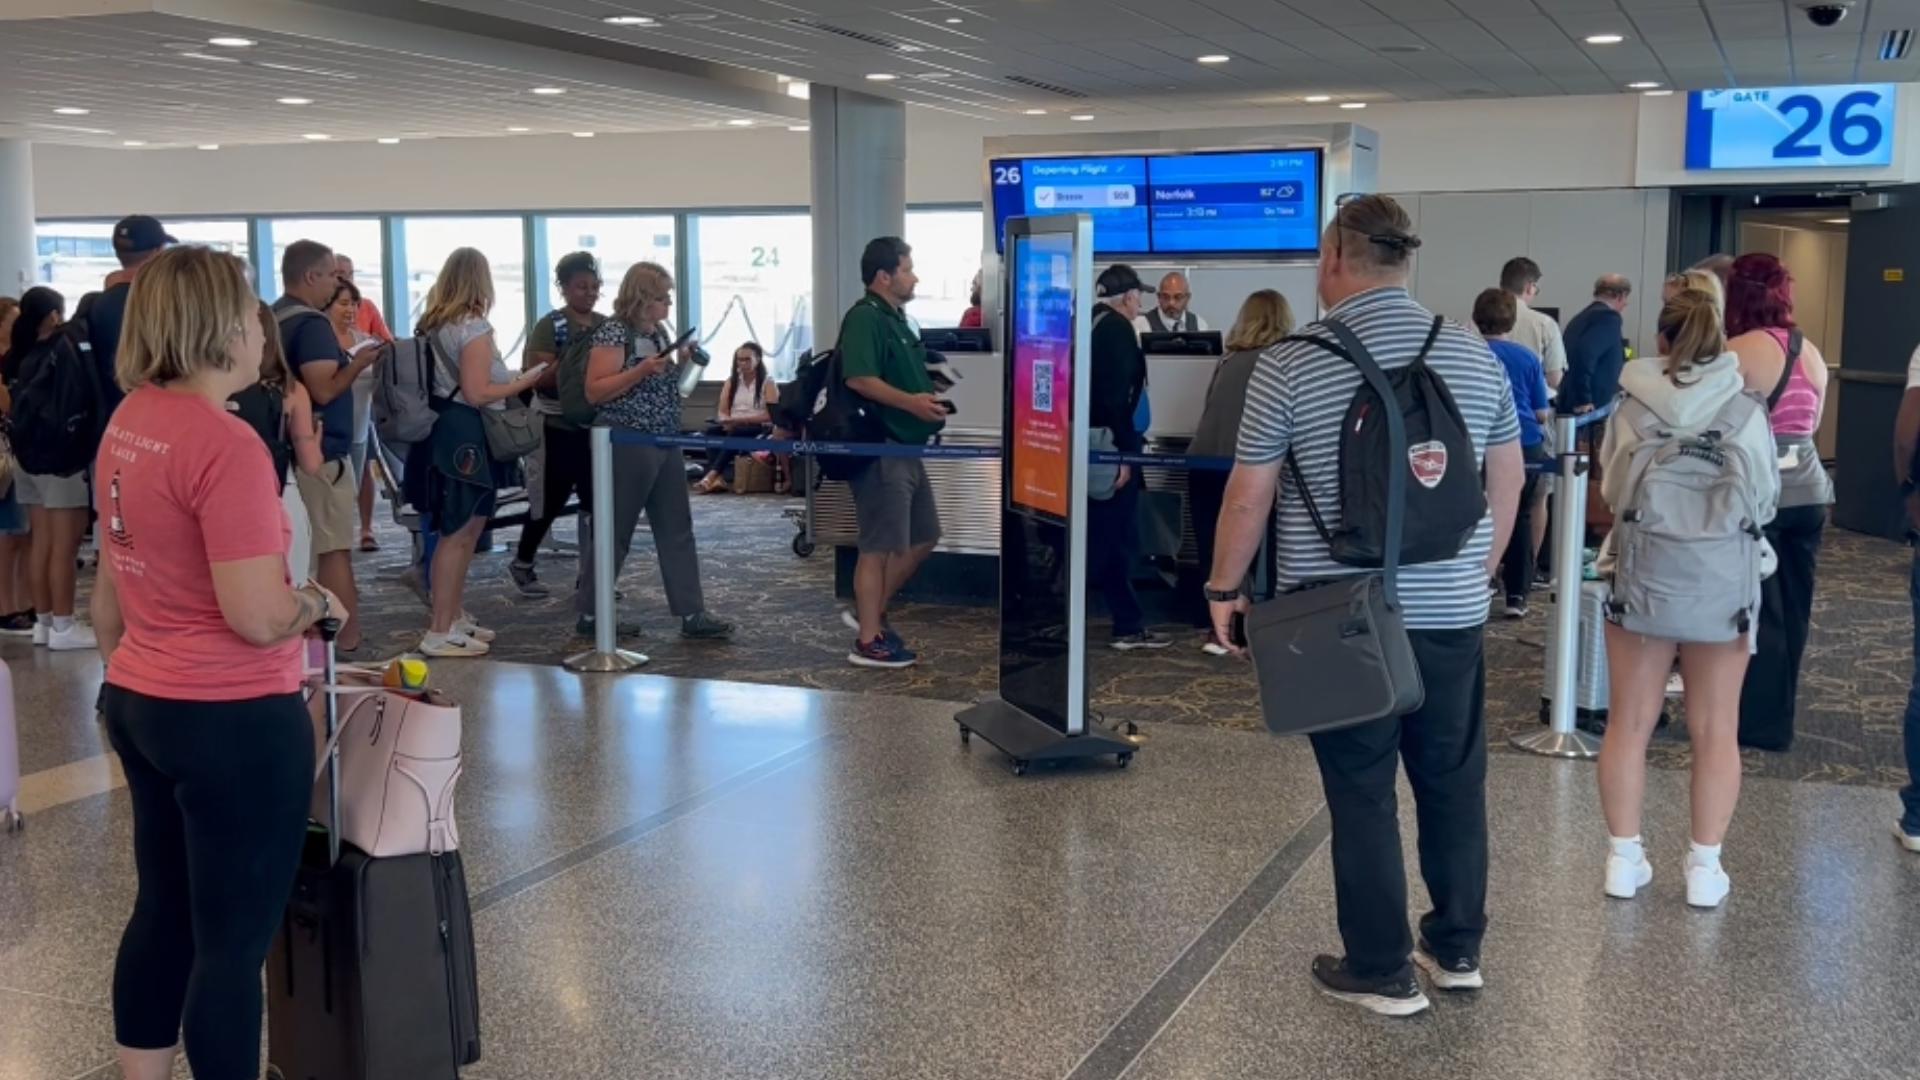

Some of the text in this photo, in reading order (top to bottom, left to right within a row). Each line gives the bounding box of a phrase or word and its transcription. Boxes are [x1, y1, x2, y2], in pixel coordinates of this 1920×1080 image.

[1733, 91, 1770, 102] GATE
[1772, 90, 1883, 159] 26
[994, 166, 1021, 185] 26
[1032, 164, 1107, 175] Departing Flight
[1155, 189, 1195, 200] Norfolk
[751, 246, 779, 267] 24
[134, 435, 171, 455] LIGHT
